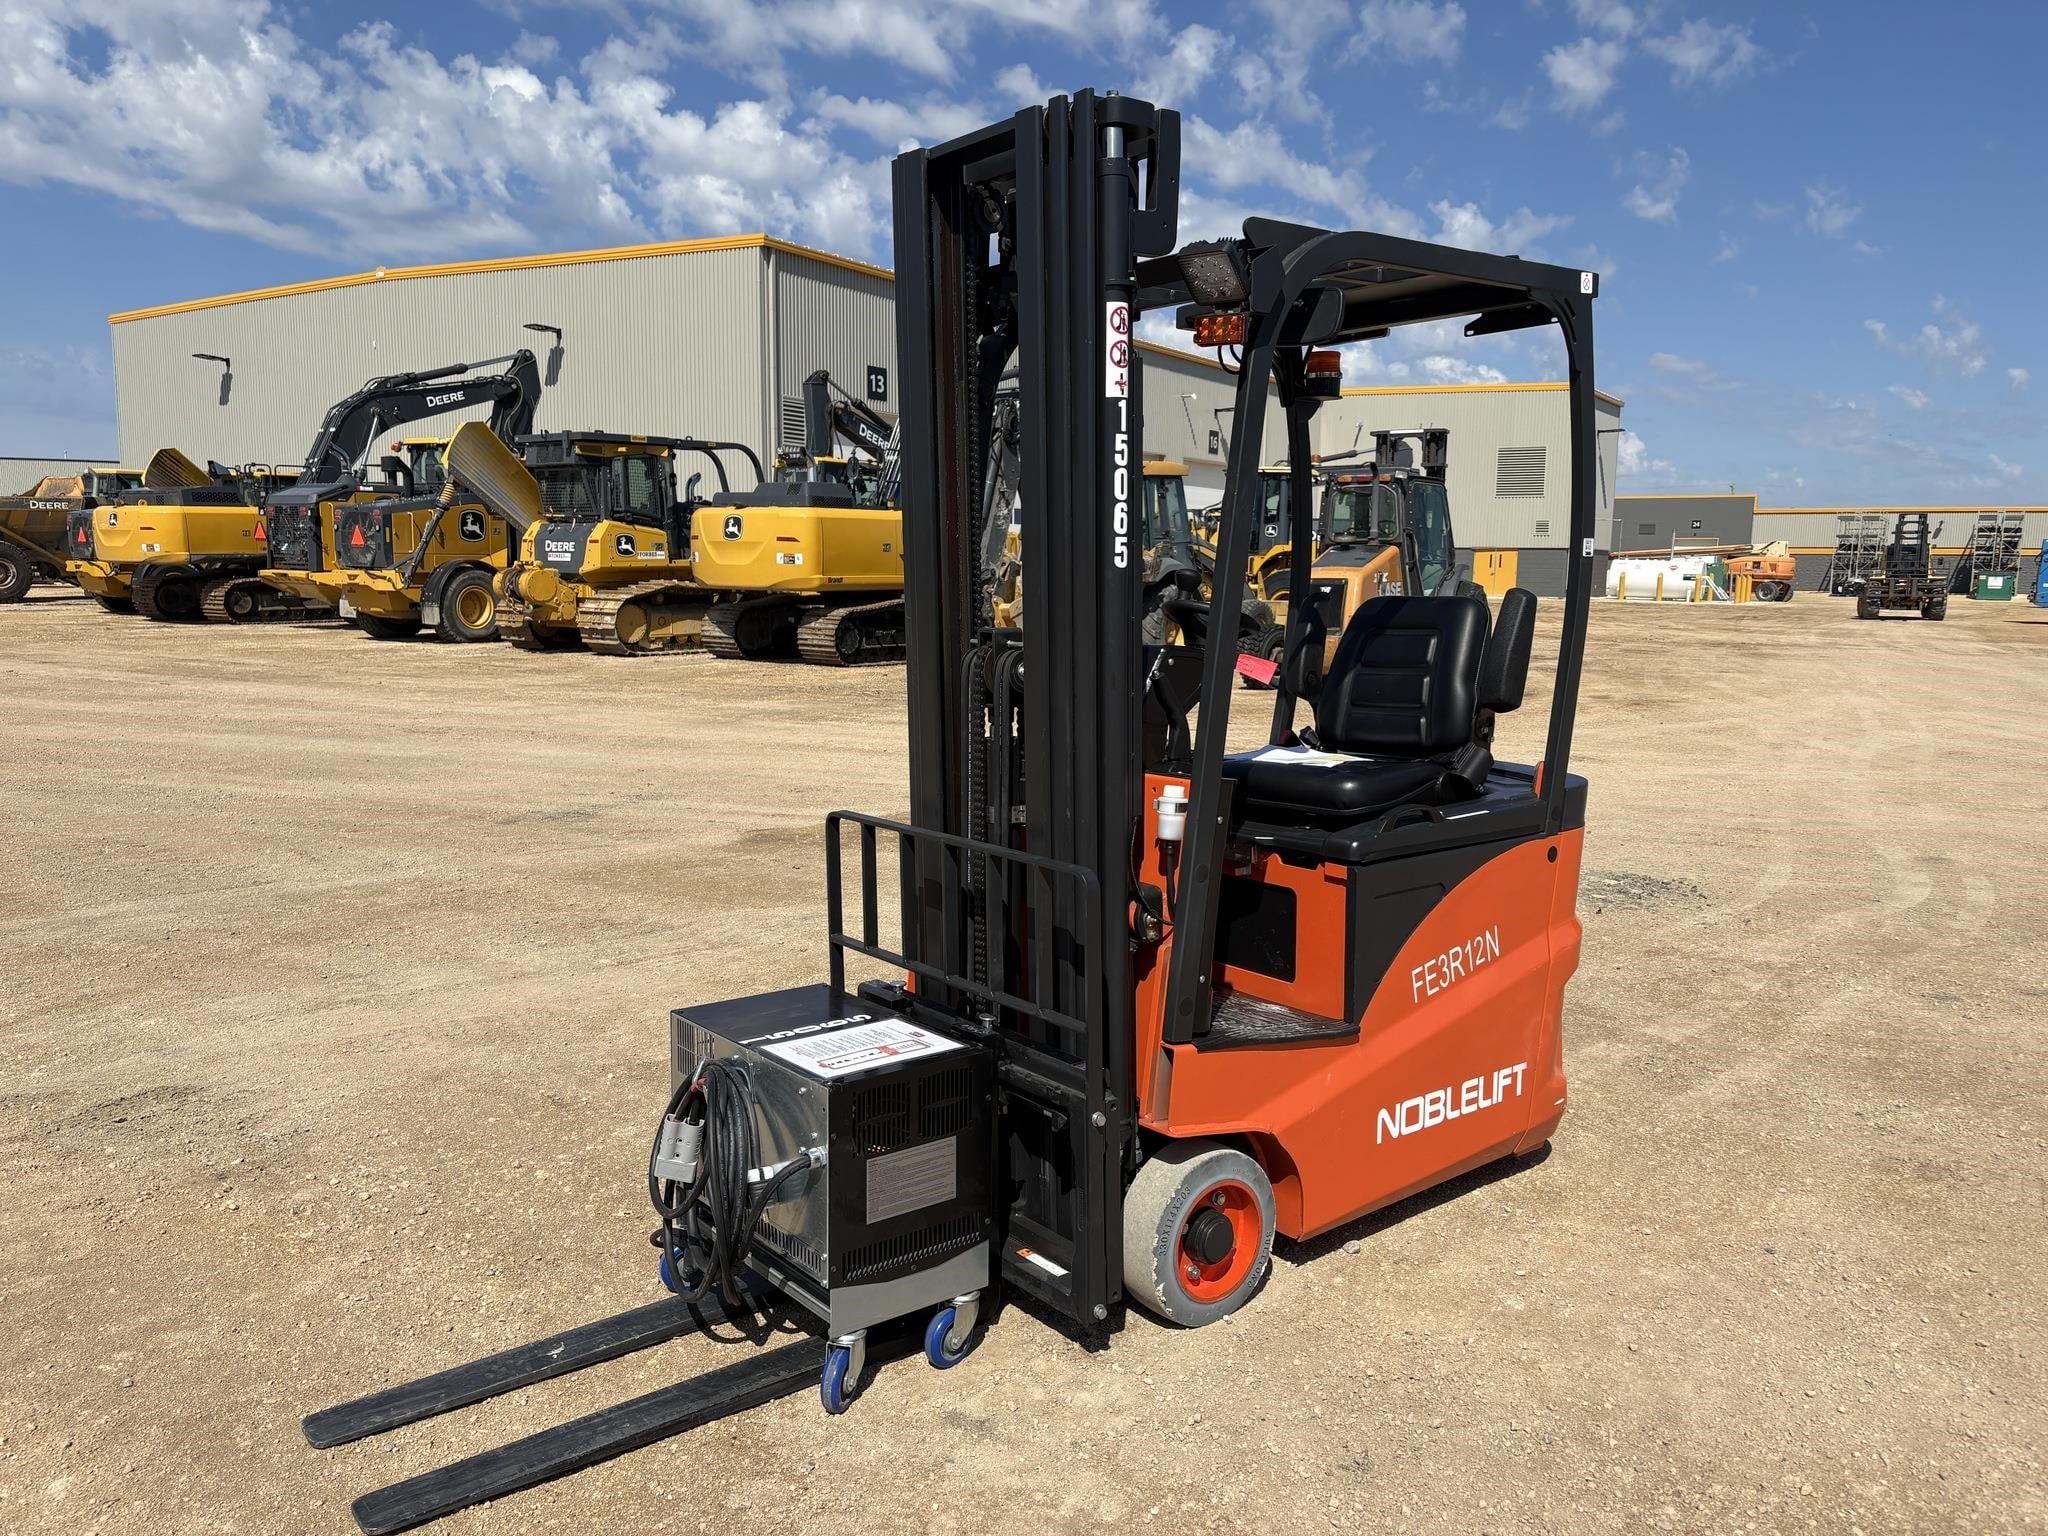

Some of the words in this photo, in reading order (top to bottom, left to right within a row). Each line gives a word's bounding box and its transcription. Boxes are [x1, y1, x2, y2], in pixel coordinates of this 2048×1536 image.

[869, 374, 885, 393] 13
[426, 391, 466, 408] DEERE
[1210, 435, 1218, 449] 16
[1113, 399, 1128, 569] 15065
[29, 500, 69, 510] DEERE
[545, 540, 576, 552] DEERE
[1411, 924, 1500, 1004] FE3R12N
[739, 1014, 872, 1045] 15065
[1376, 1061, 1528, 1145] NOBLELIFT
